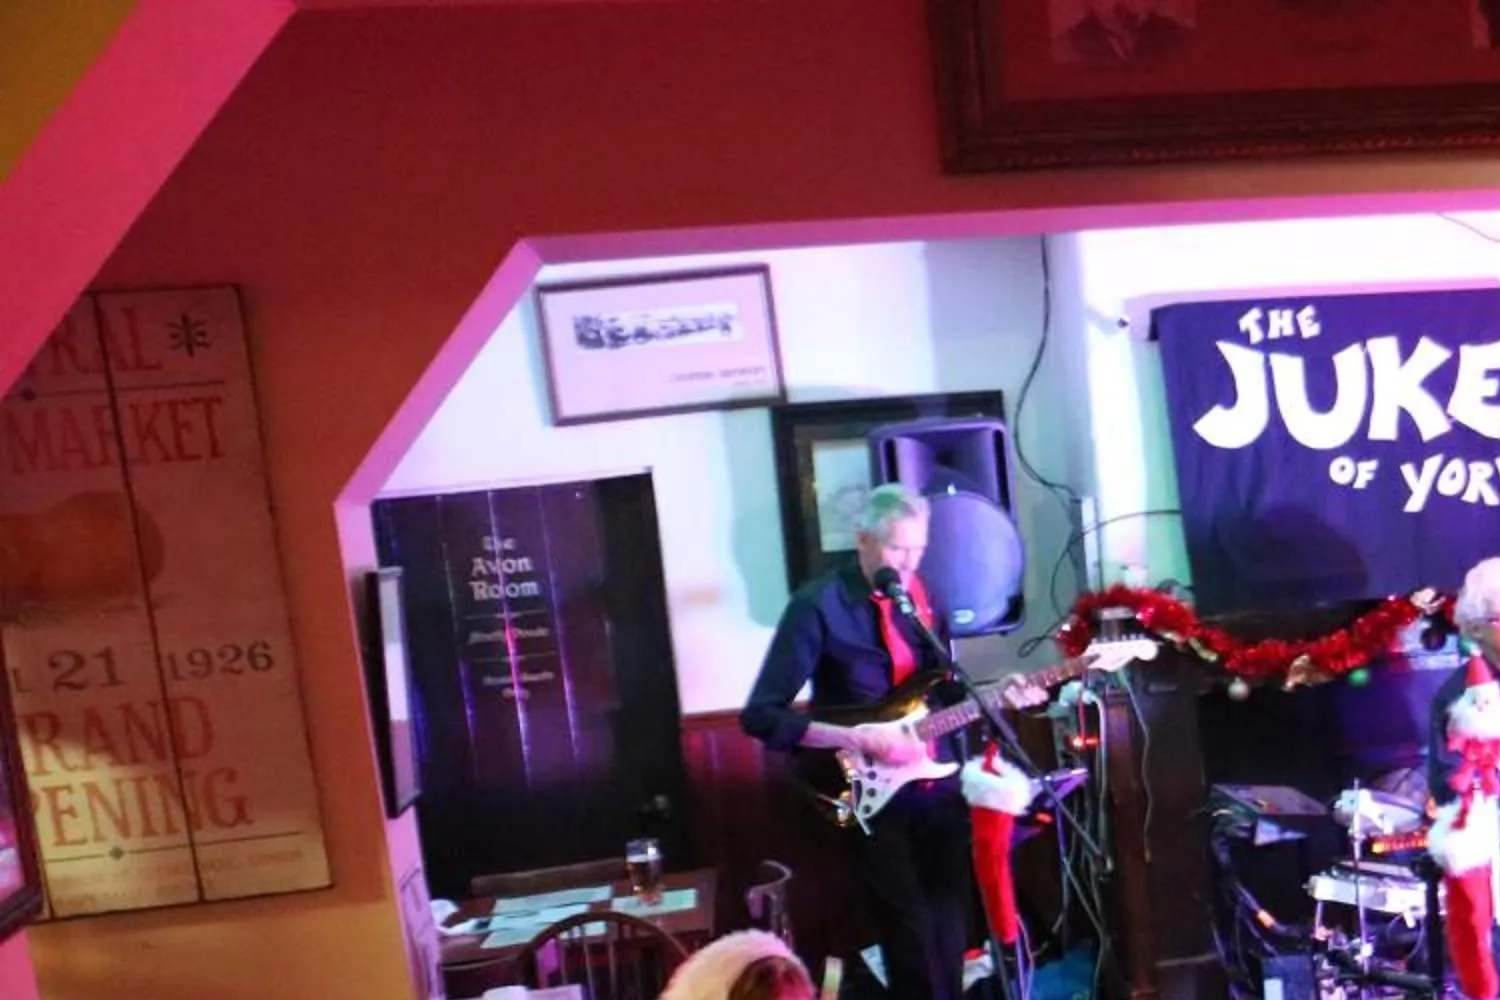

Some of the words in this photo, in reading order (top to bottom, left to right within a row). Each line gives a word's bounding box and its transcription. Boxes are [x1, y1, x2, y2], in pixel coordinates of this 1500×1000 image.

[28, 306, 164, 376] RAL
[1238, 305, 1321, 344] THE
[1329, 455, 1379, 490] OF
[471, 556, 534, 578] Avon
[468, 580, 540, 602] Room
[47, 646, 127, 691] 21
[165, 640, 275, 682] 1926
